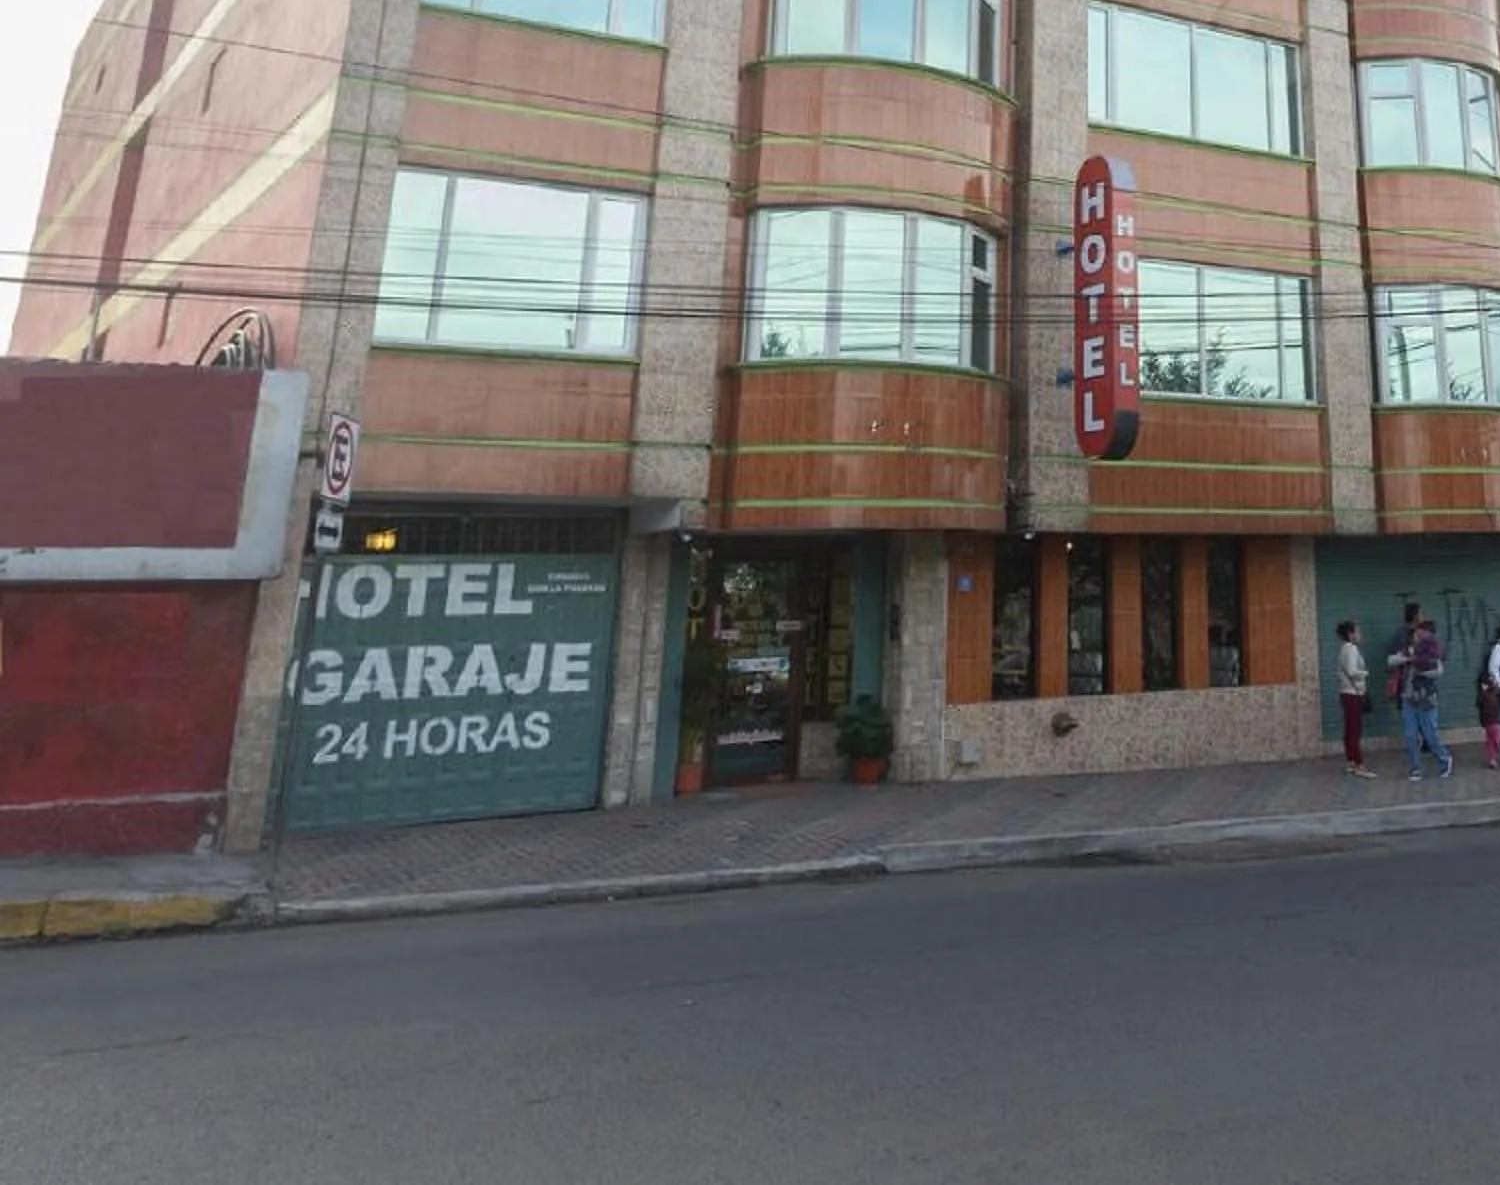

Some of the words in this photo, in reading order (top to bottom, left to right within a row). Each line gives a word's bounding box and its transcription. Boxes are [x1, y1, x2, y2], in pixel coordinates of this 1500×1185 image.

[1080, 182, 1107, 433] HOTEL
[1117, 215, 1134, 386] HOTEL
[287, 643, 593, 706] GARAJE
[313, 722, 369, 764] 24
[383, 711, 551, 760] HORAS
